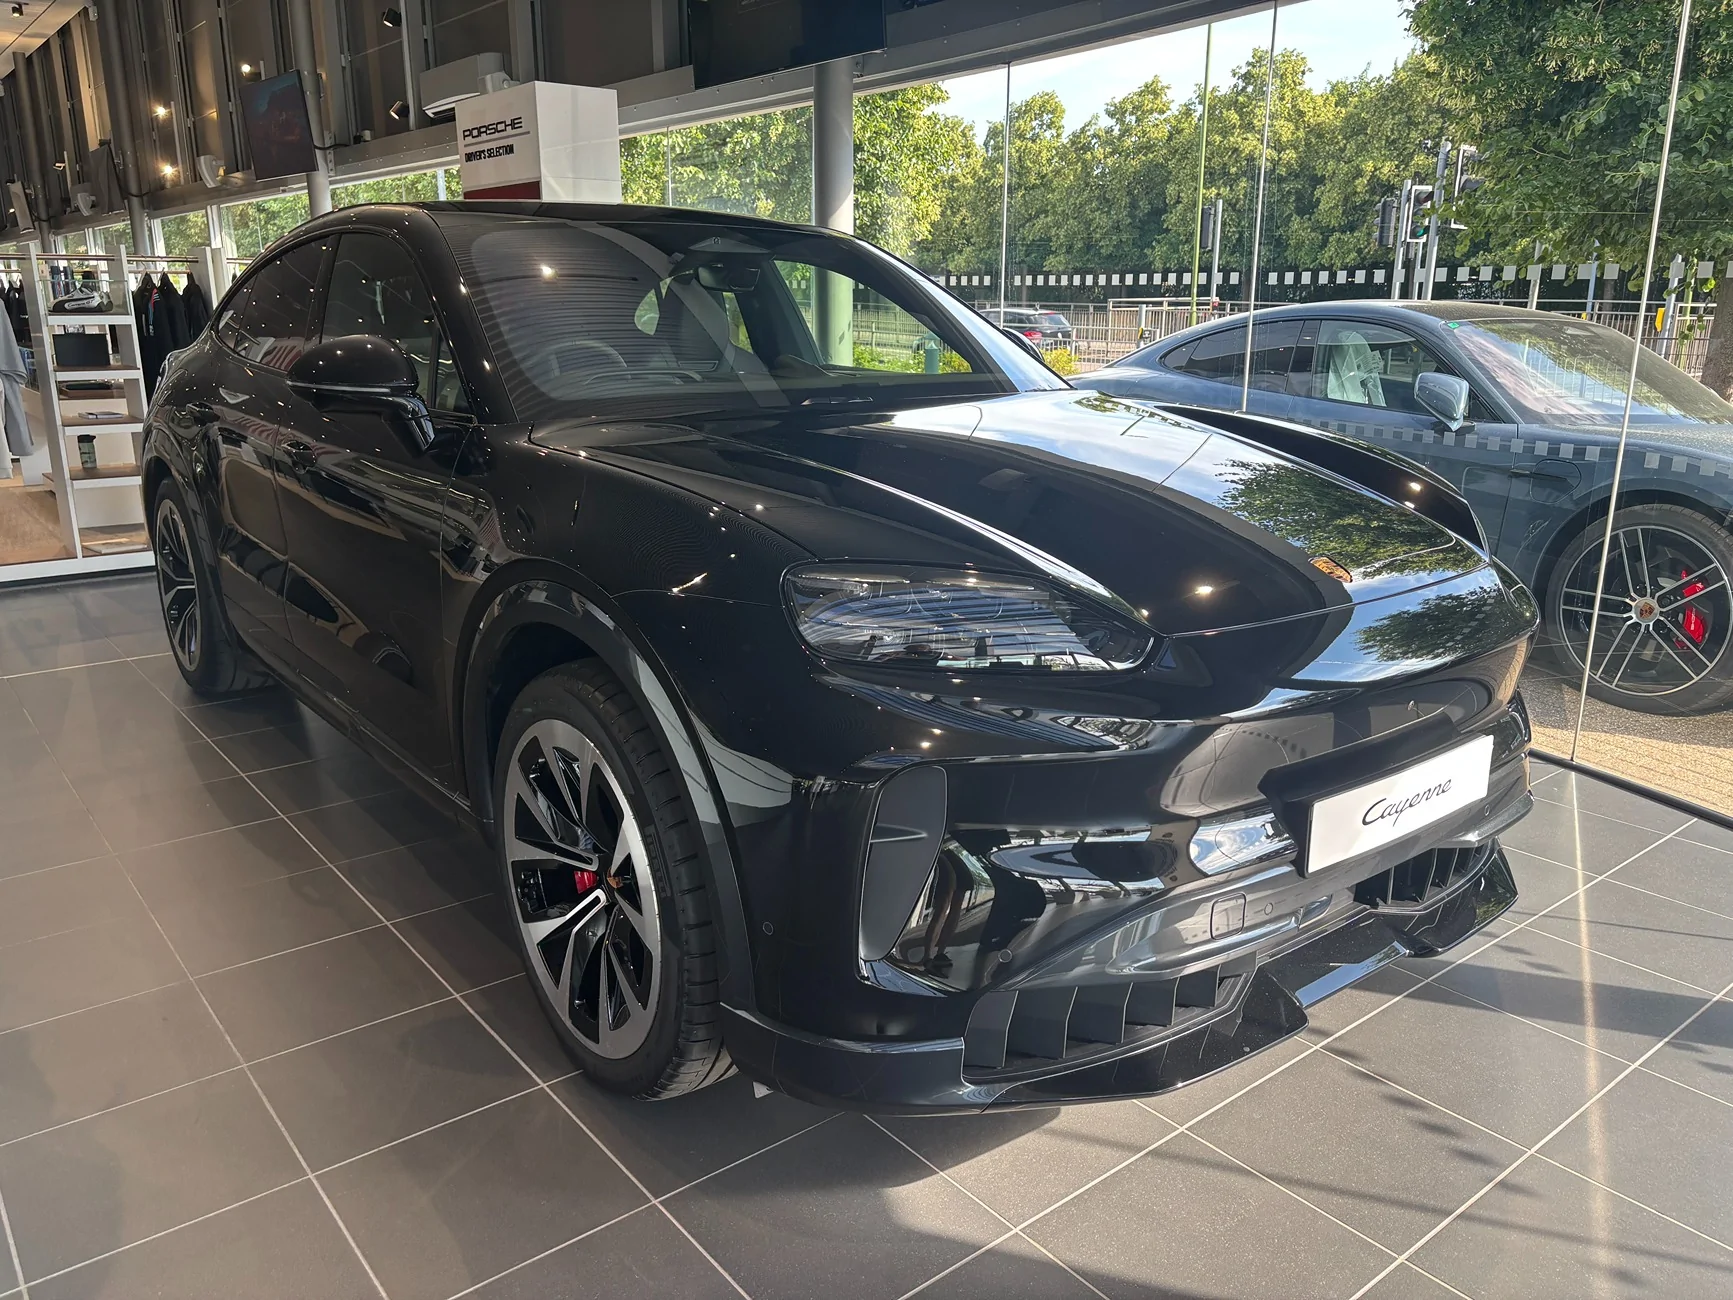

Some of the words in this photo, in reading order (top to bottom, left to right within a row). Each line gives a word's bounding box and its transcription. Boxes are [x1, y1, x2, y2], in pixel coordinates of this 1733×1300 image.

[463, 116, 522, 141] PORSCHE
[465, 149, 486, 162] DRIVER'S
[487, 144, 514, 159] SELECTION
[1362, 779, 1452, 827] Cayenne
